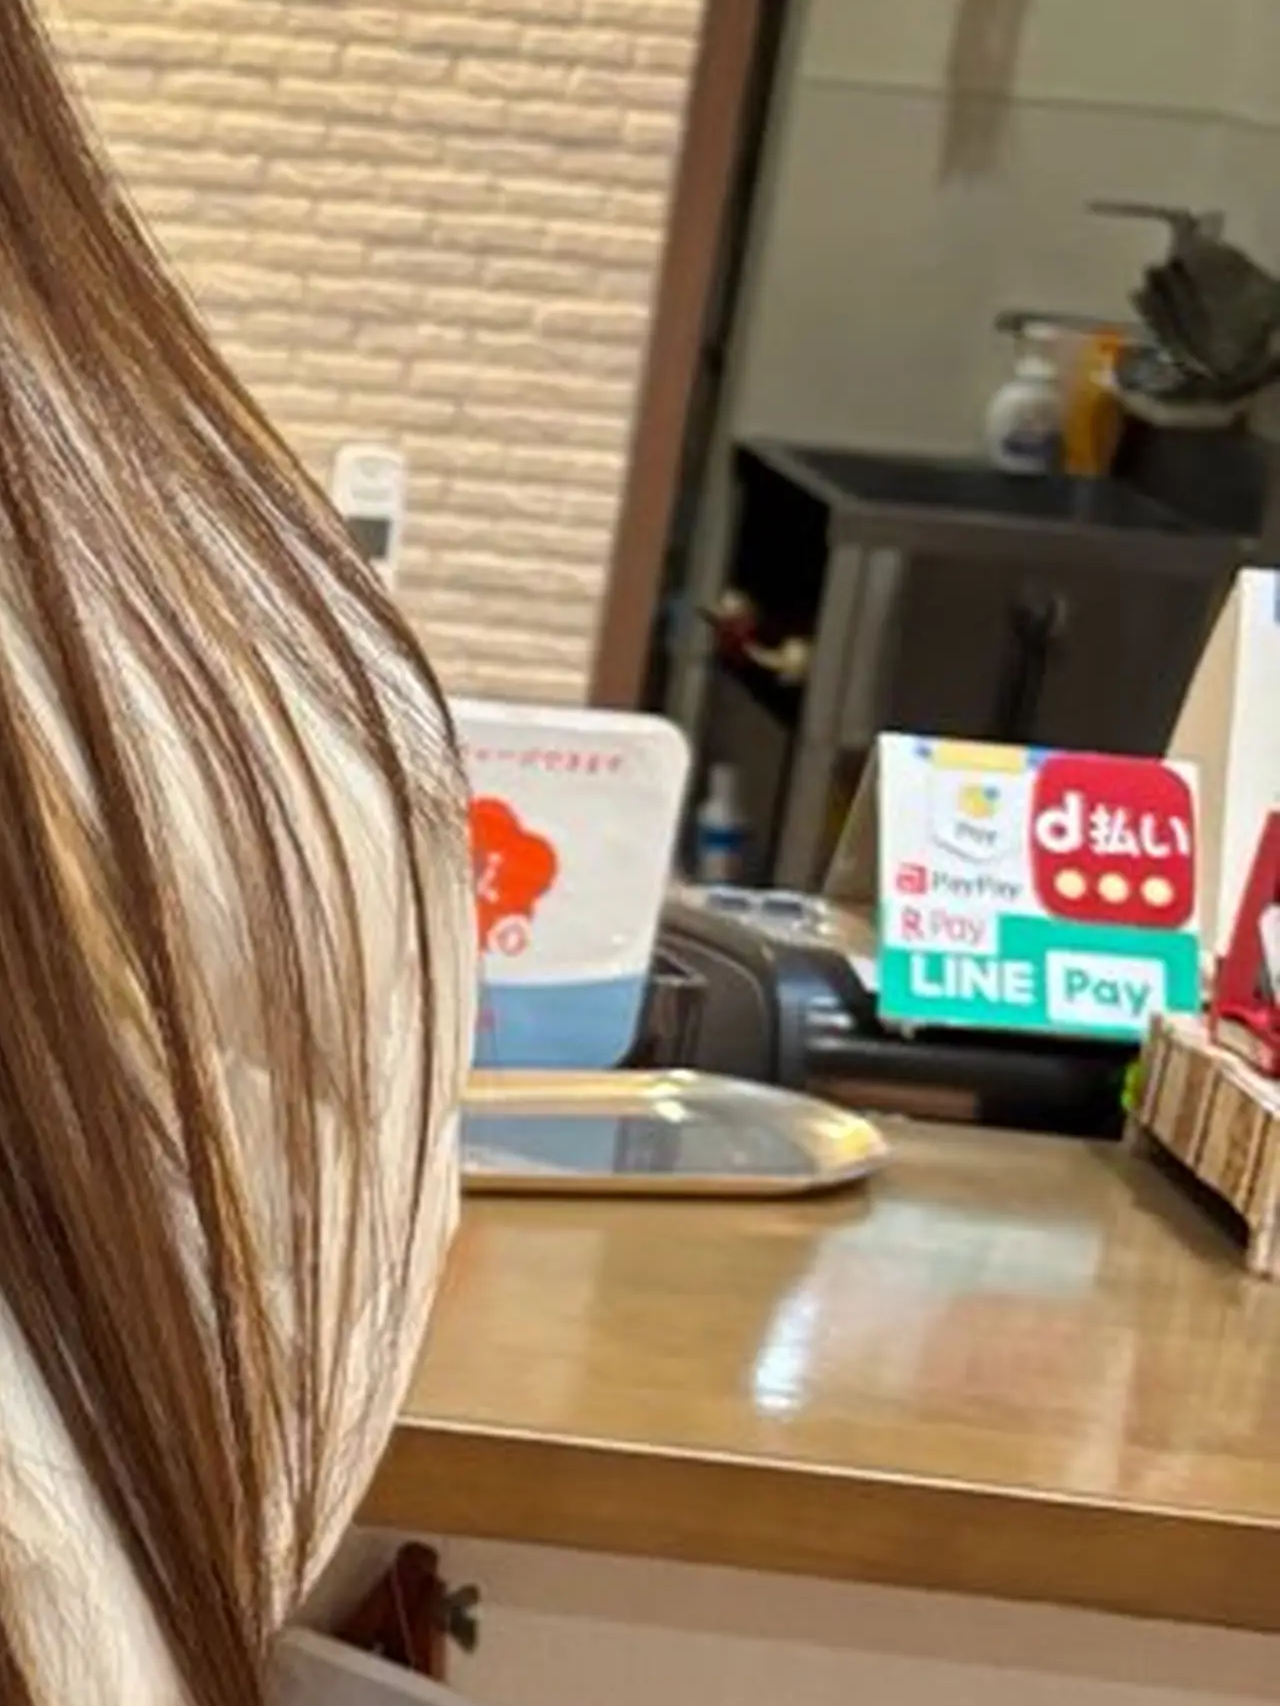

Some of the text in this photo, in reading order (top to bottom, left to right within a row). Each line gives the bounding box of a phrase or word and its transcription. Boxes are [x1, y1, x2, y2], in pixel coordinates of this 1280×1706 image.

[930, 909, 986, 945] Pay
[910, 953, 1152, 1017] LINE Pay
